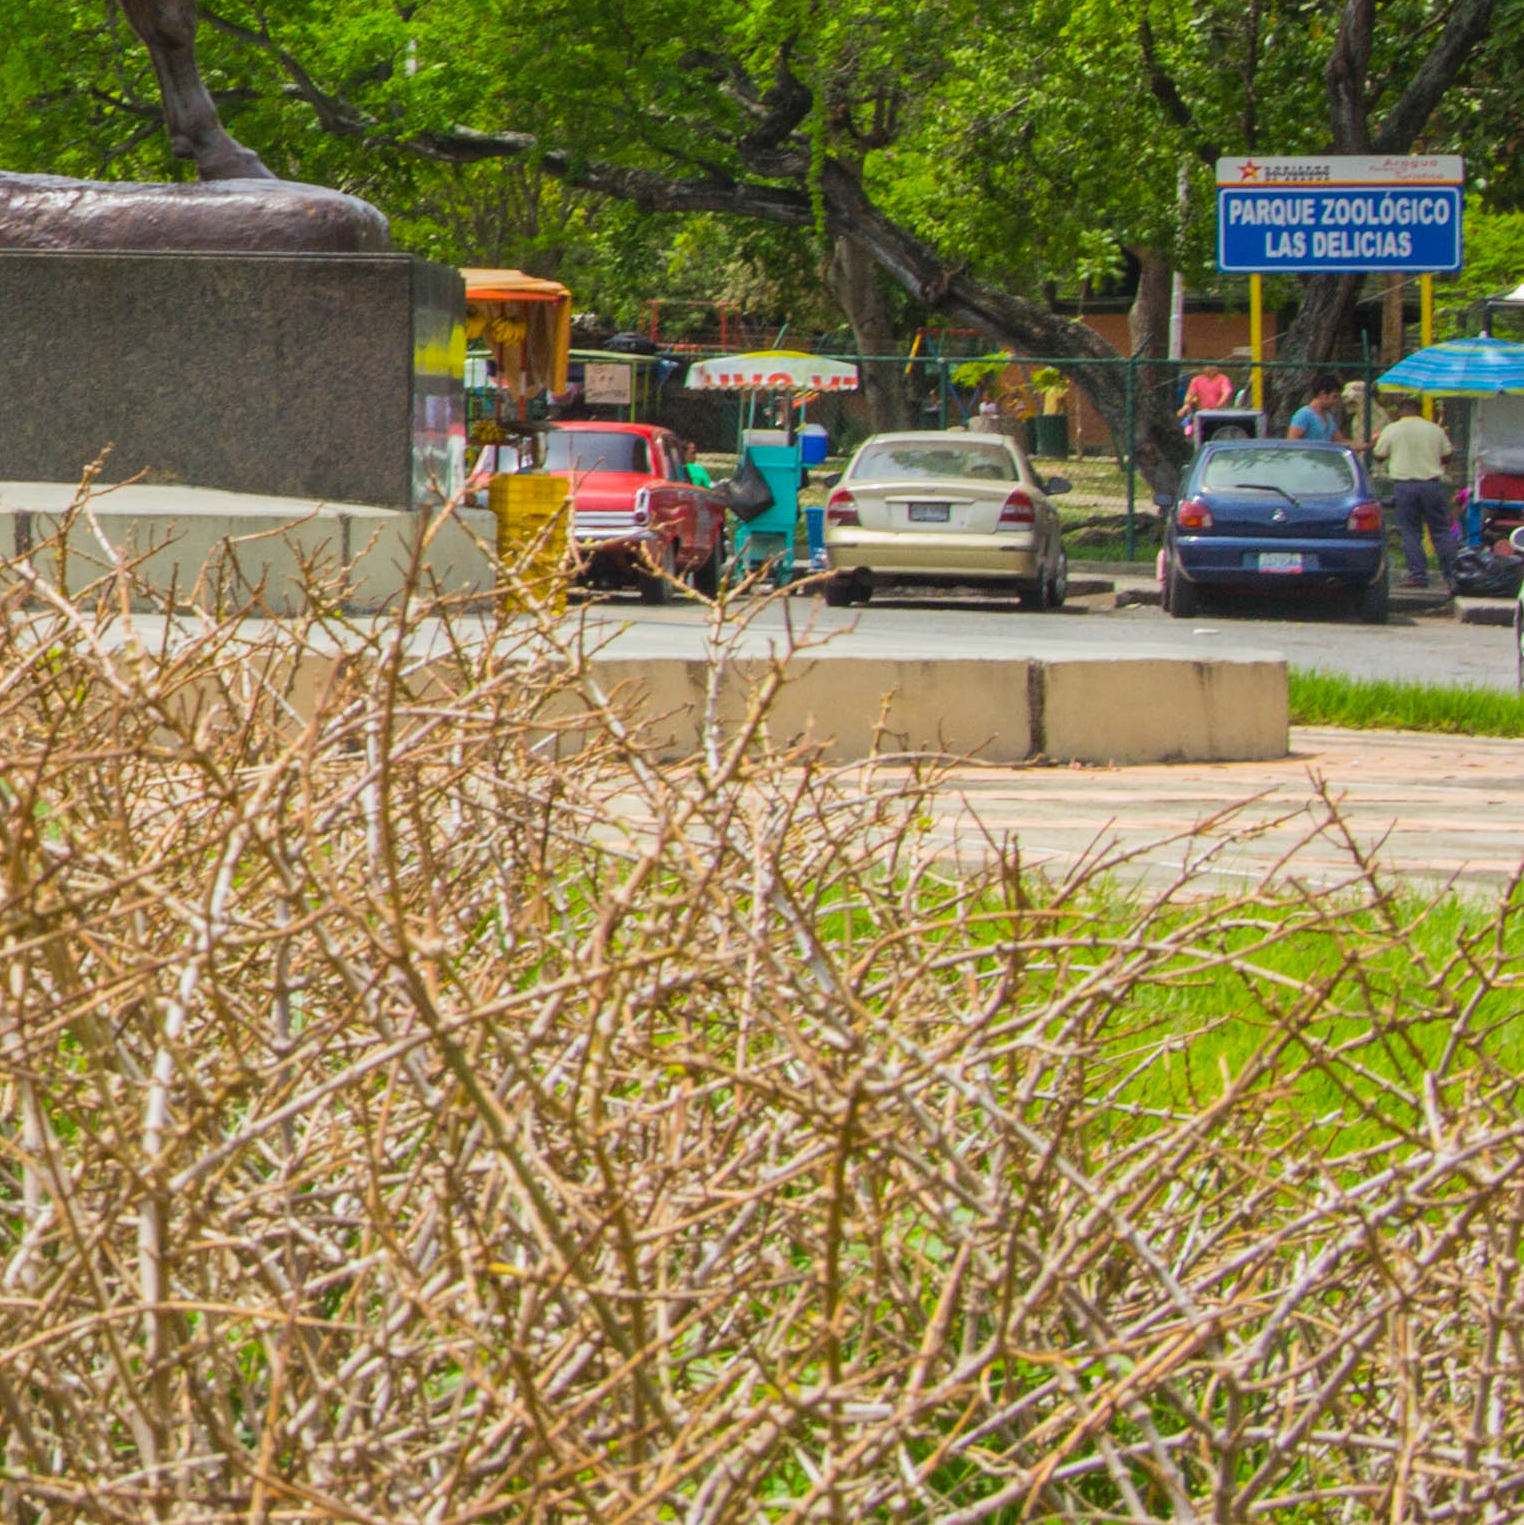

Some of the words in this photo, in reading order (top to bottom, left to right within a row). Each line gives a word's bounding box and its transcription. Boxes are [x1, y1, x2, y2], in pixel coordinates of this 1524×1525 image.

[1230, 198, 1316, 226] PARQUE
[1321, 192, 1450, 226] ZOOLÓGICO
[1265, 231, 1307, 259] LAS
[1312, 230, 1413, 259] DELICIAS
